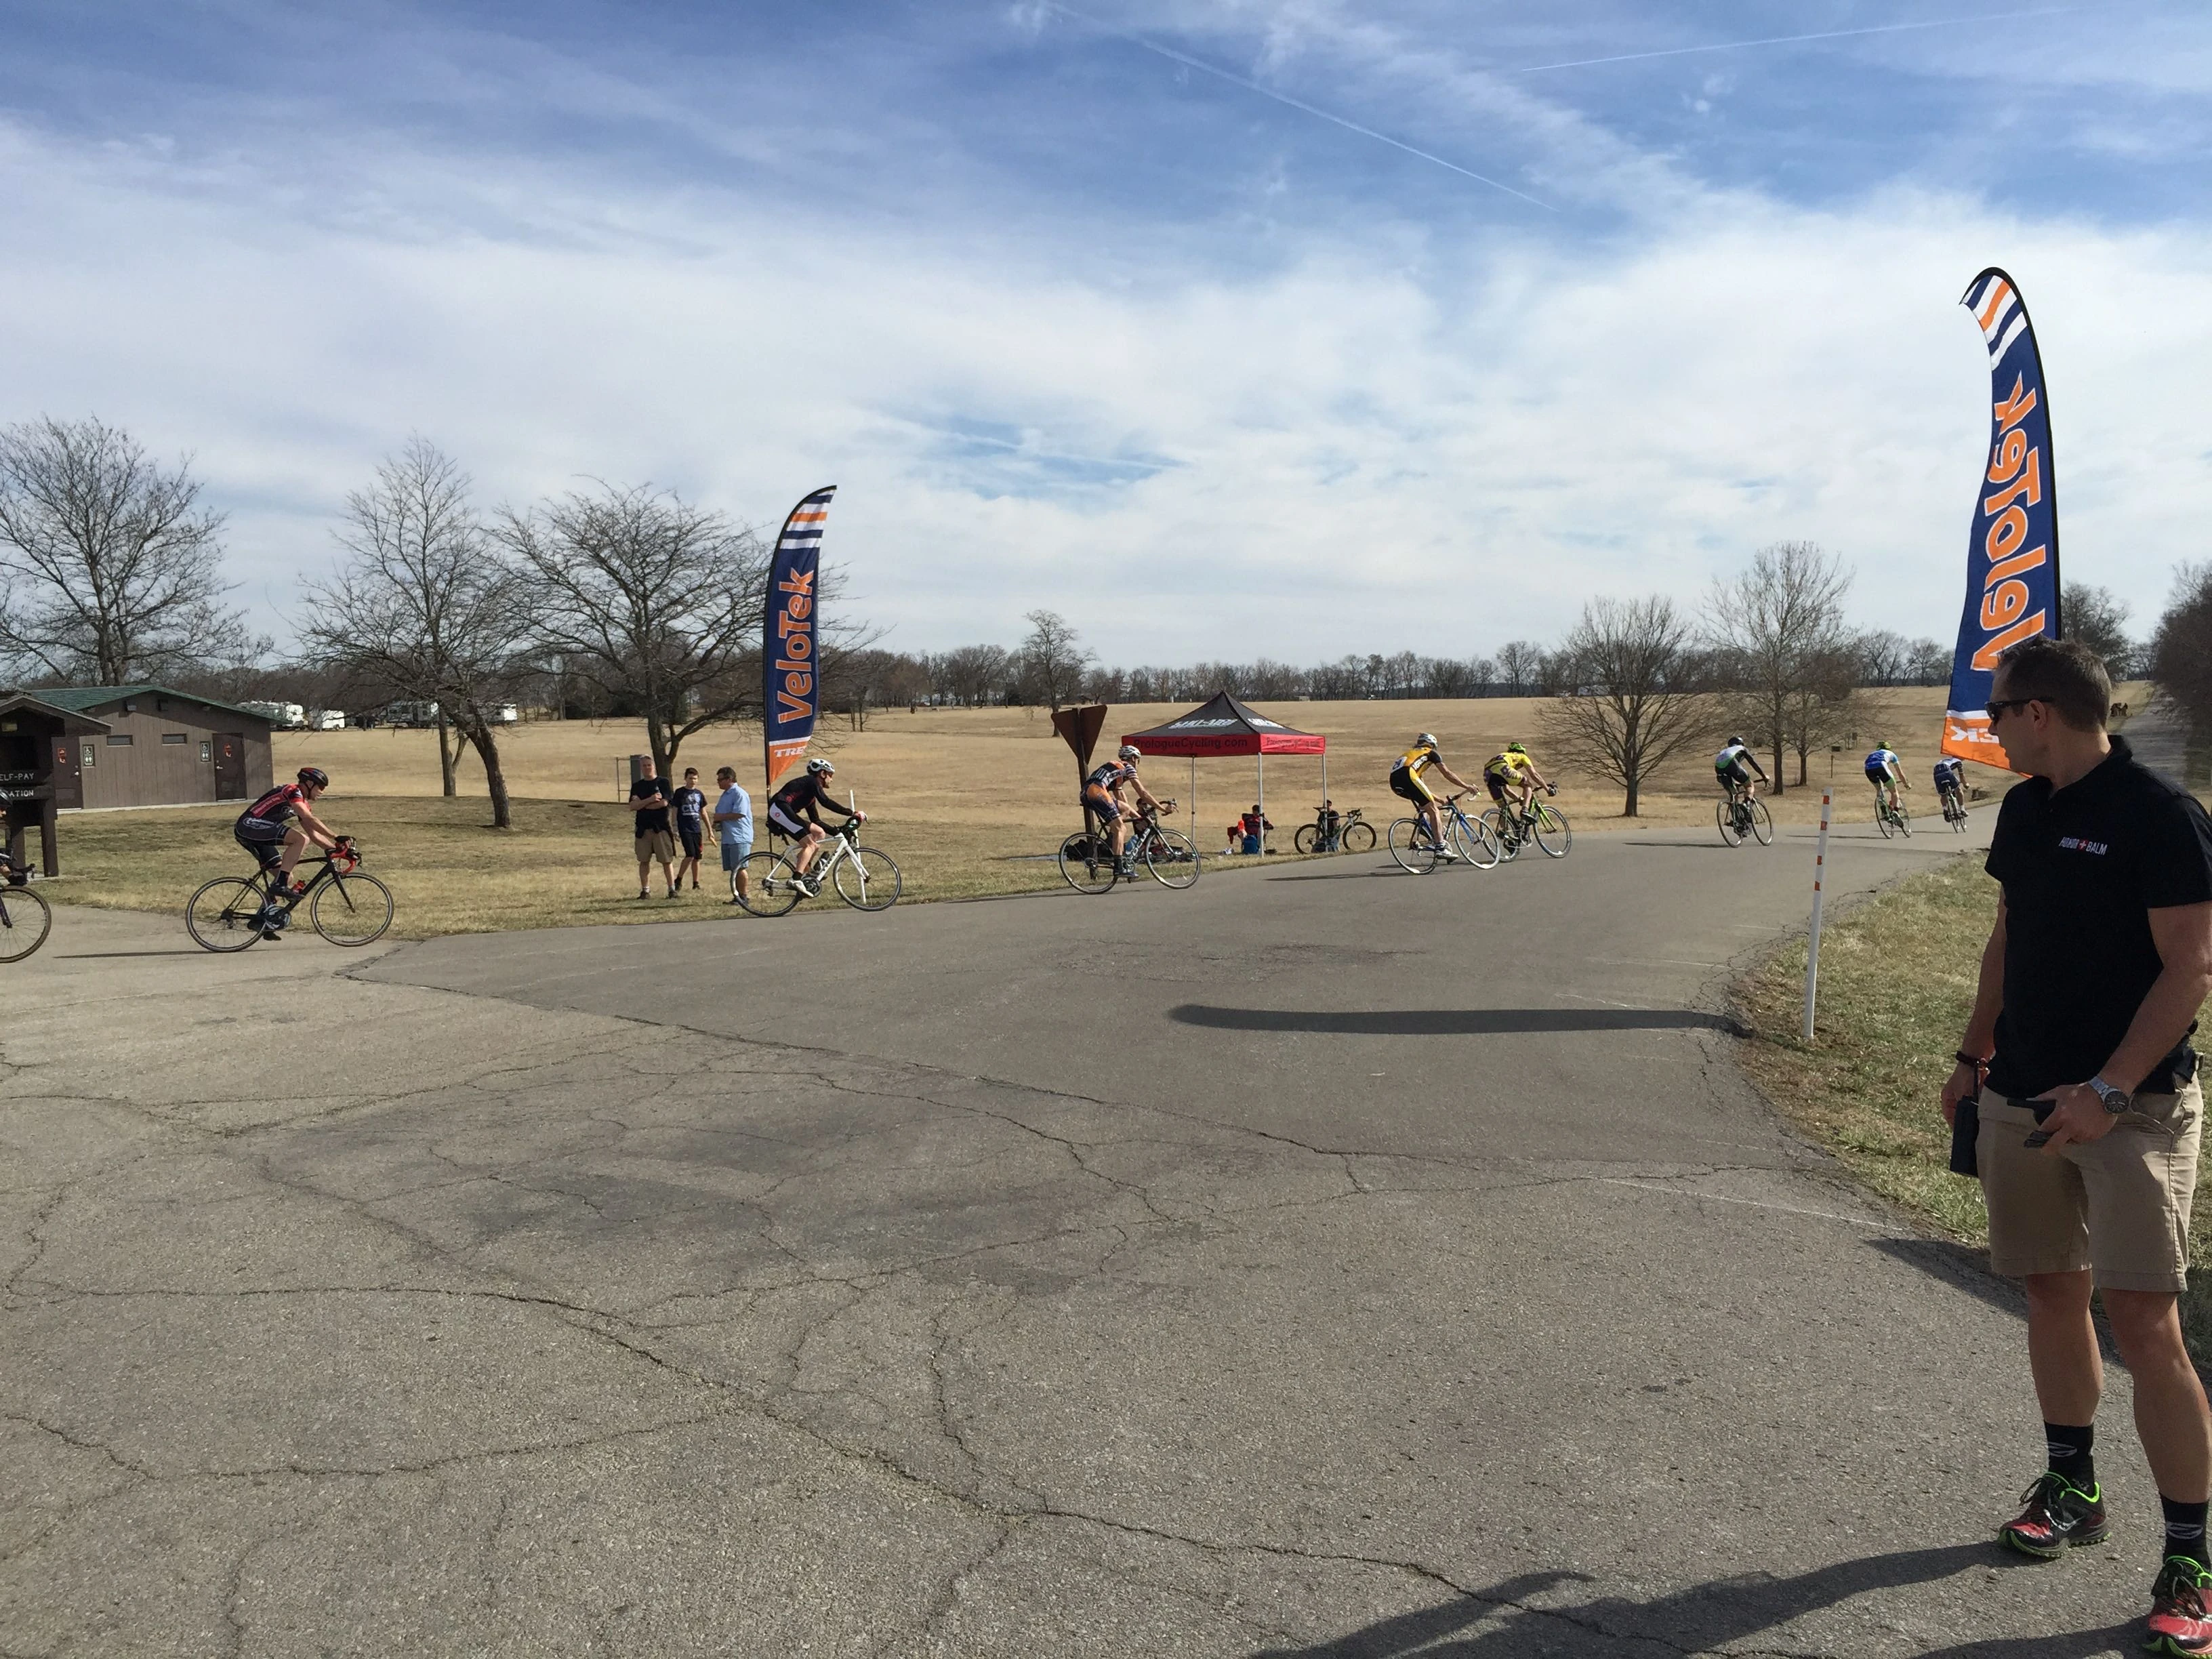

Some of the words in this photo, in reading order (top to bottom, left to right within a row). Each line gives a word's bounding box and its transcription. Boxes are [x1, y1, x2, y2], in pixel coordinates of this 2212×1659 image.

[776, 567, 814, 724] VeloTek
[774, 745, 806, 758] TRE
[0, 773, 34, 781] ELF-PAY
[2085, 841, 2108, 855] BALM
